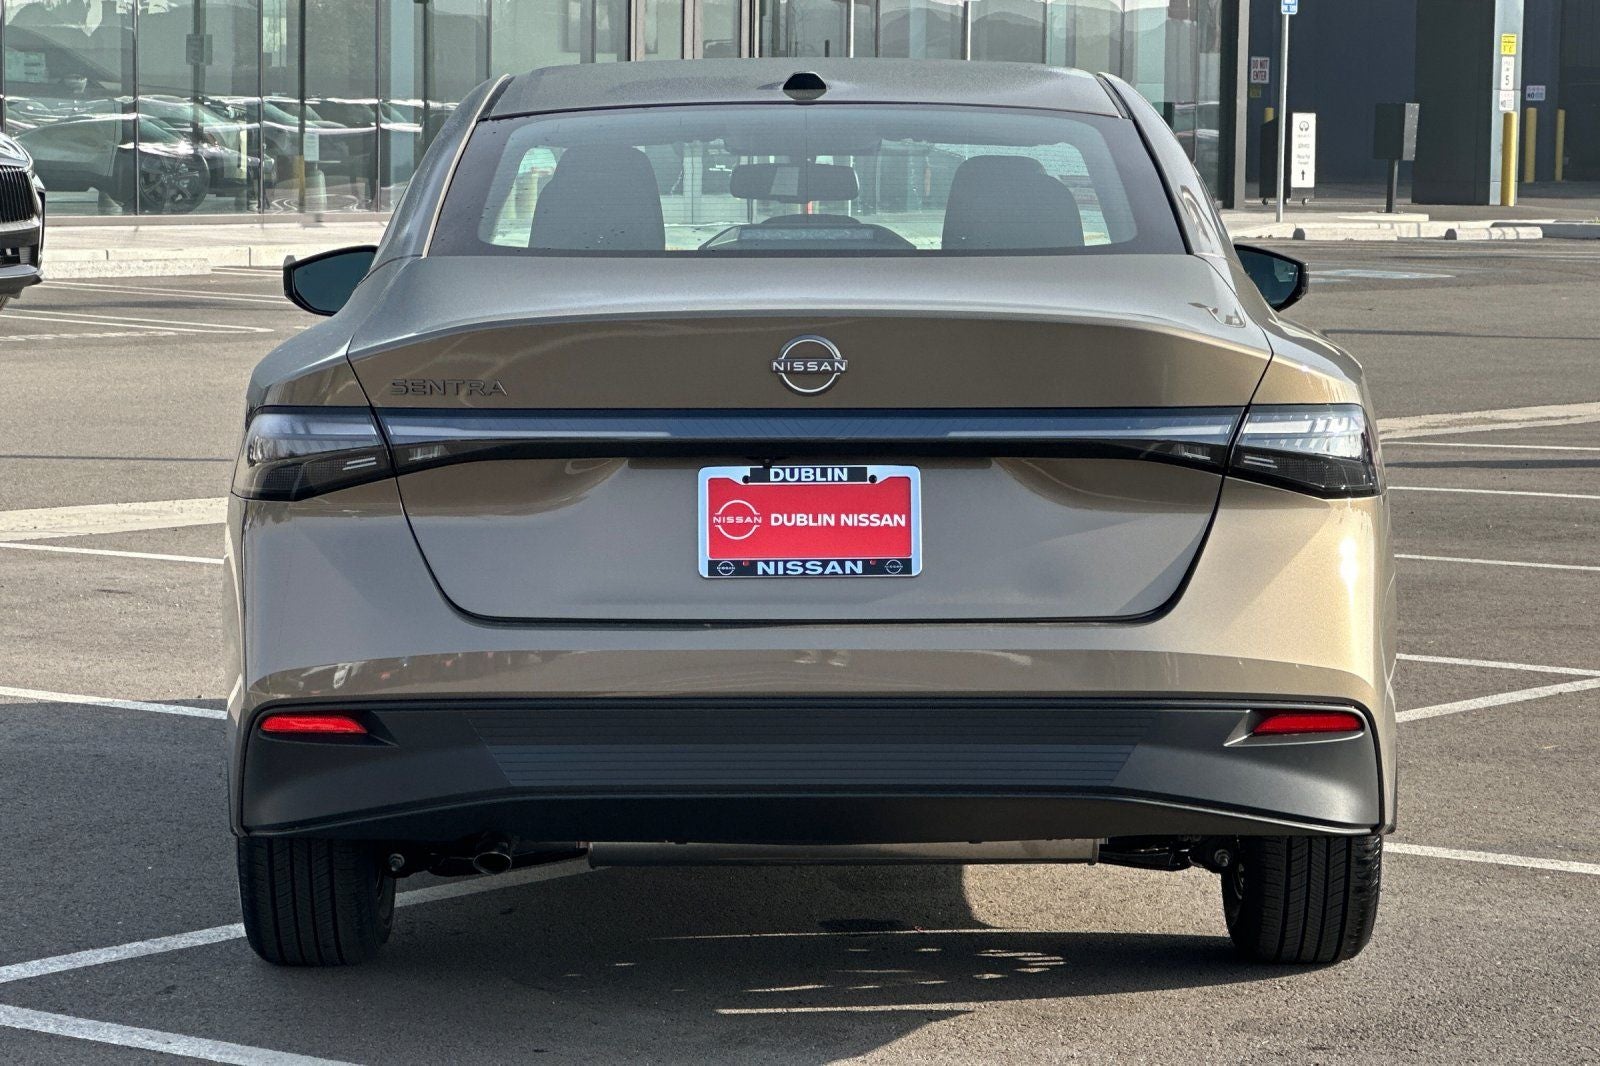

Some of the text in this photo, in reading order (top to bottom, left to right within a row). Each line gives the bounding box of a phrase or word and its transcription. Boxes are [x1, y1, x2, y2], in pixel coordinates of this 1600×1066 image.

[1259, 59, 1268, 69] NOT
[1252, 70, 1267, 81] ENTER
[772, 361, 847, 372] NISSAN
[391, 379, 508, 396] SENTRA
[769, 467, 848, 482] DUBLIN
[713, 516, 762, 525] NISSAN
[770, 513, 906, 527] DUBLIN NISSAN
[757, 561, 863, 575] NISSAN
